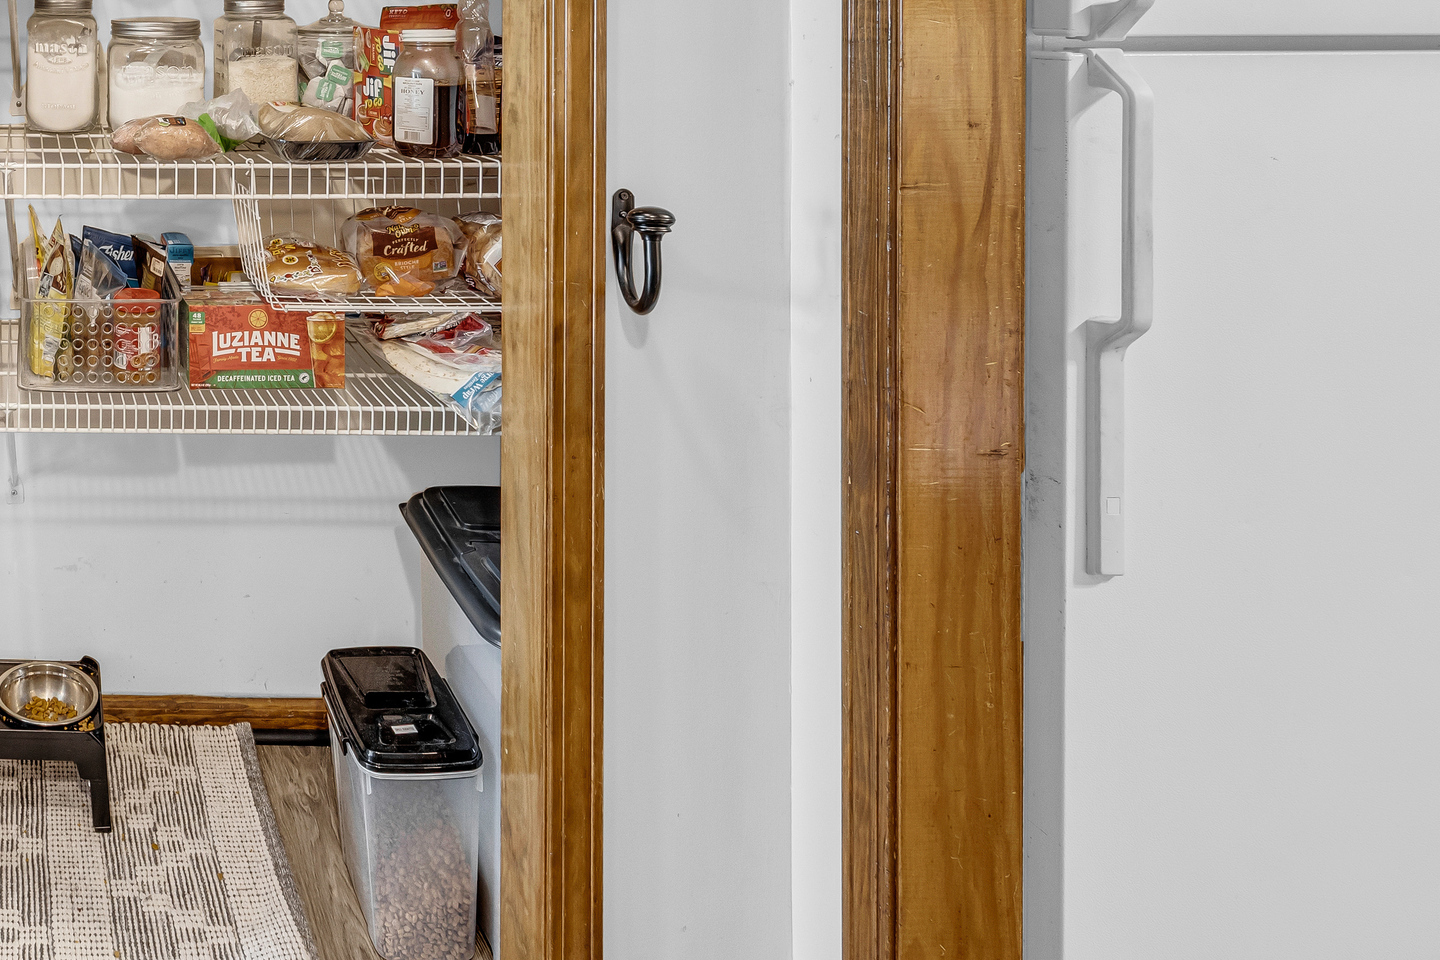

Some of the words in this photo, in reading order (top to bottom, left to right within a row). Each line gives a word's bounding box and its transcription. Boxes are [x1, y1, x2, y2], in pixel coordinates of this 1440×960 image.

[363, 77, 382, 98] Jif
[383, 240, 428, 257] Crafted
[394, 259, 420, 267] BRIOCHE
[211, 330, 301, 357] LUZIANNE
[237, 347, 276, 362] TEA
[217, 374, 266, 382] DECAFFEINATED
[267, 374, 282, 382] ICED
[283, 374, 296, 382] TEA
